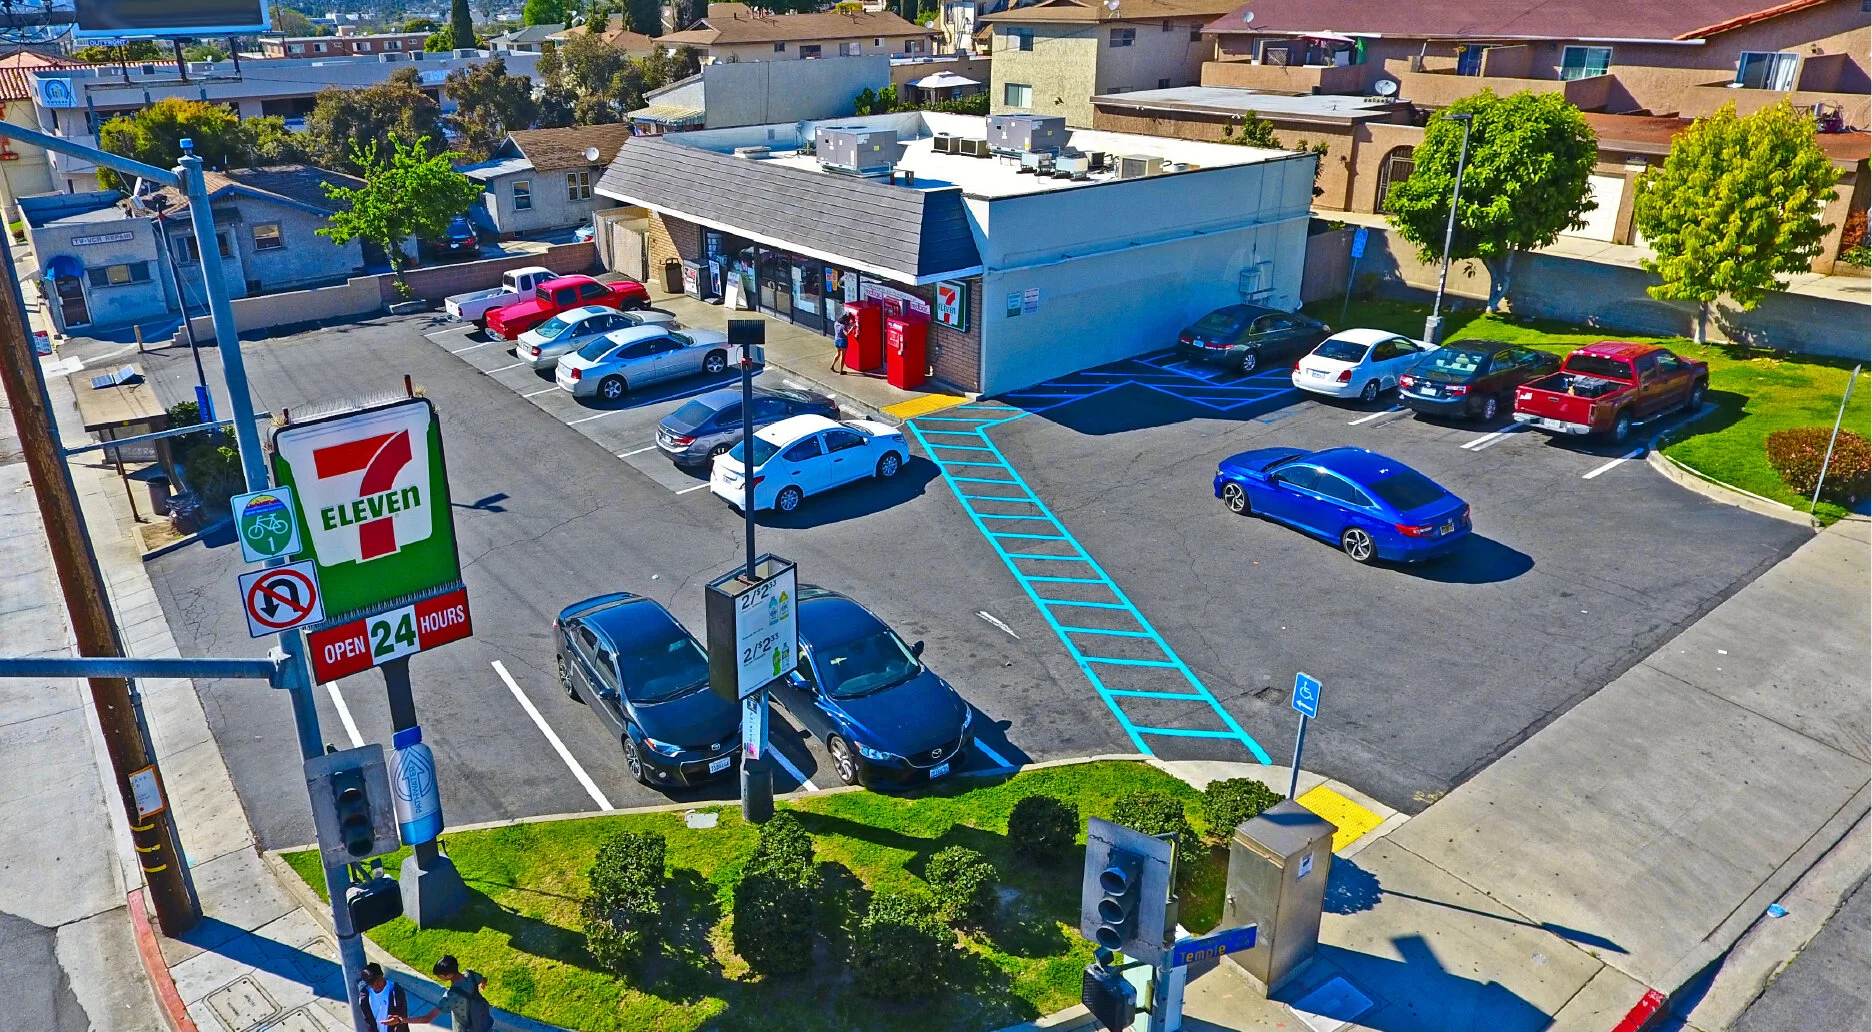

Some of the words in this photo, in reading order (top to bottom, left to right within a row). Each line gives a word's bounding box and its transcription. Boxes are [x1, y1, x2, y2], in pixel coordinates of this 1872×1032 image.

[105, 233, 131, 241] REPAIR
[313, 429, 413, 560] 7
[267, 536, 275, 552] 1
[324, 635, 366, 664] OPEN
[370, 612, 417, 658] 24
[420, 604, 466, 634] HOURS
[408, 766, 422, 813] PATHWATER
[1180, 944, 1226, 964] Temple
